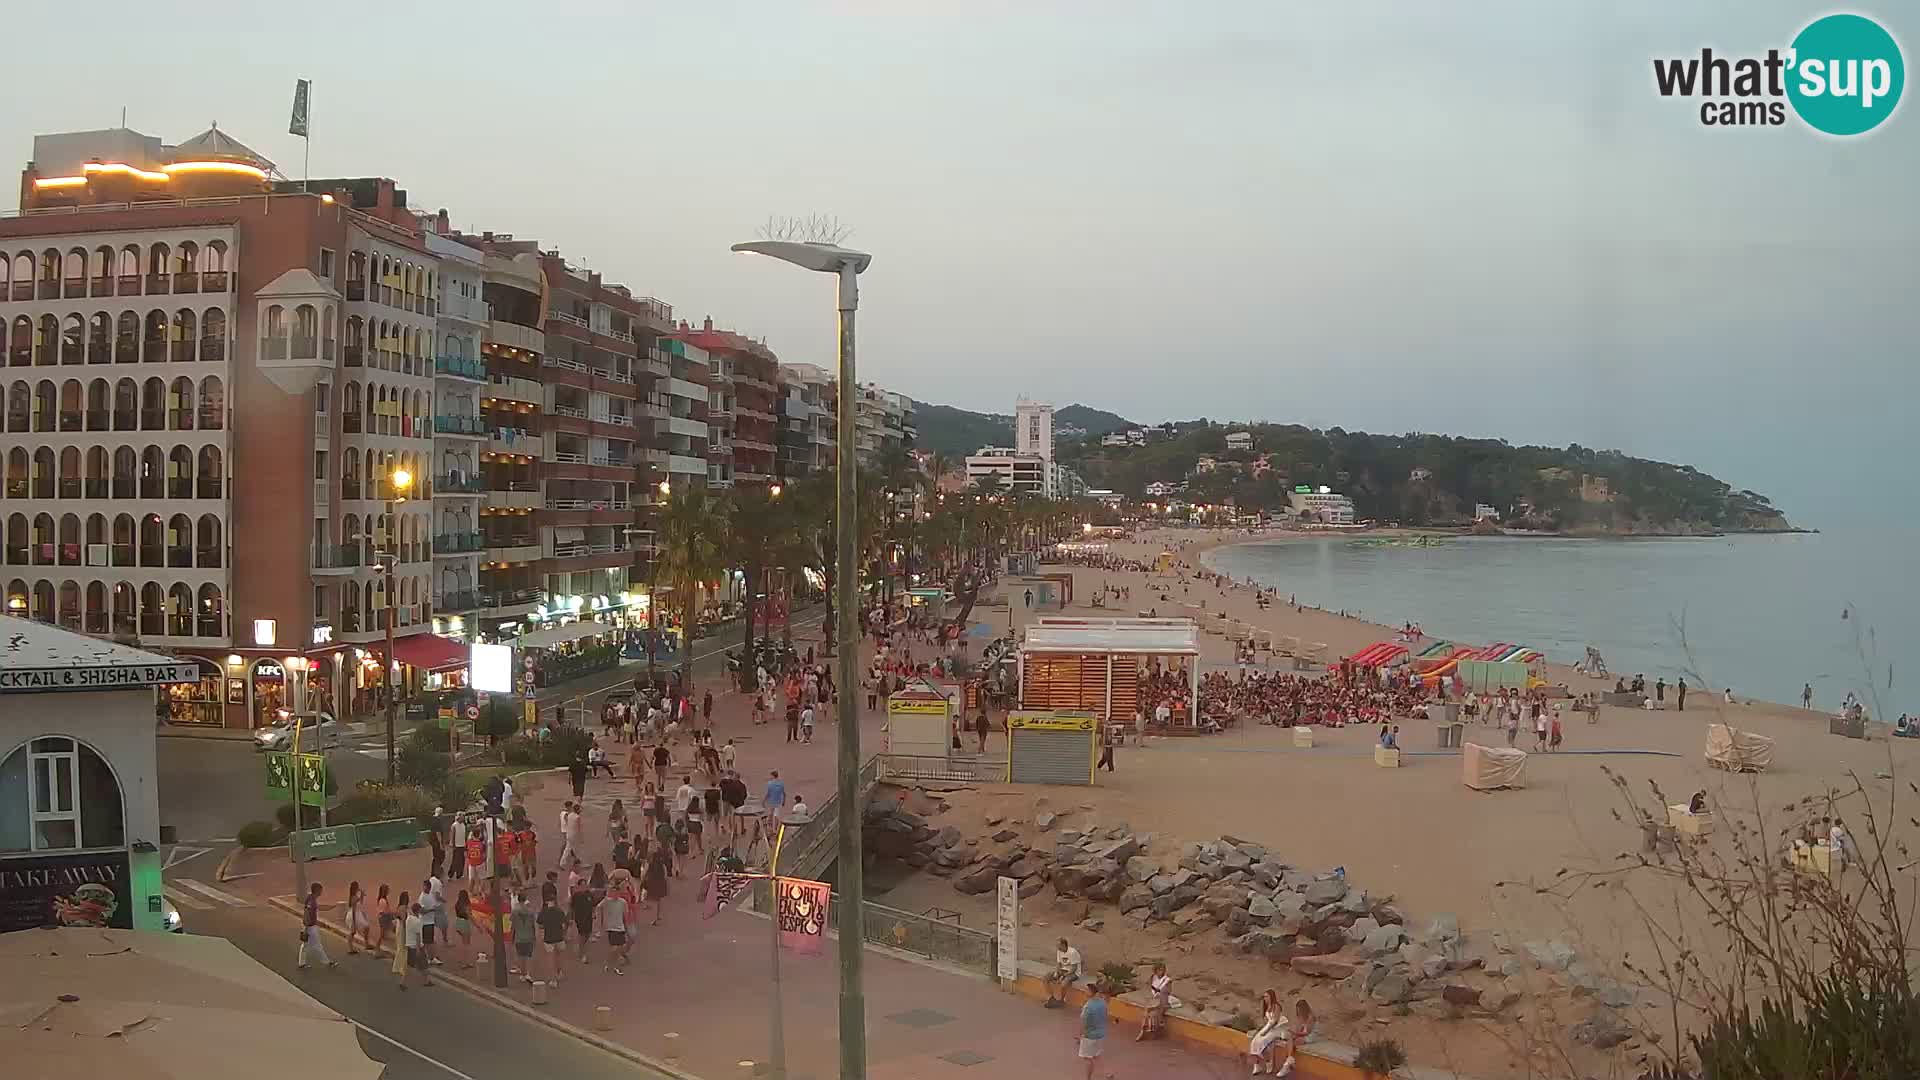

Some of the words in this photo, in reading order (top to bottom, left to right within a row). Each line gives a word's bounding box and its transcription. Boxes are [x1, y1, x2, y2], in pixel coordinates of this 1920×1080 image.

[313, 625, 333, 643] KFC
[63, 669, 74, 685] &
[80, 668, 141, 684] SHISHA
[145, 667, 178, 682] BAR
[257, 665, 281, 675] KFC
[779, 915, 825, 937] RESPECT
